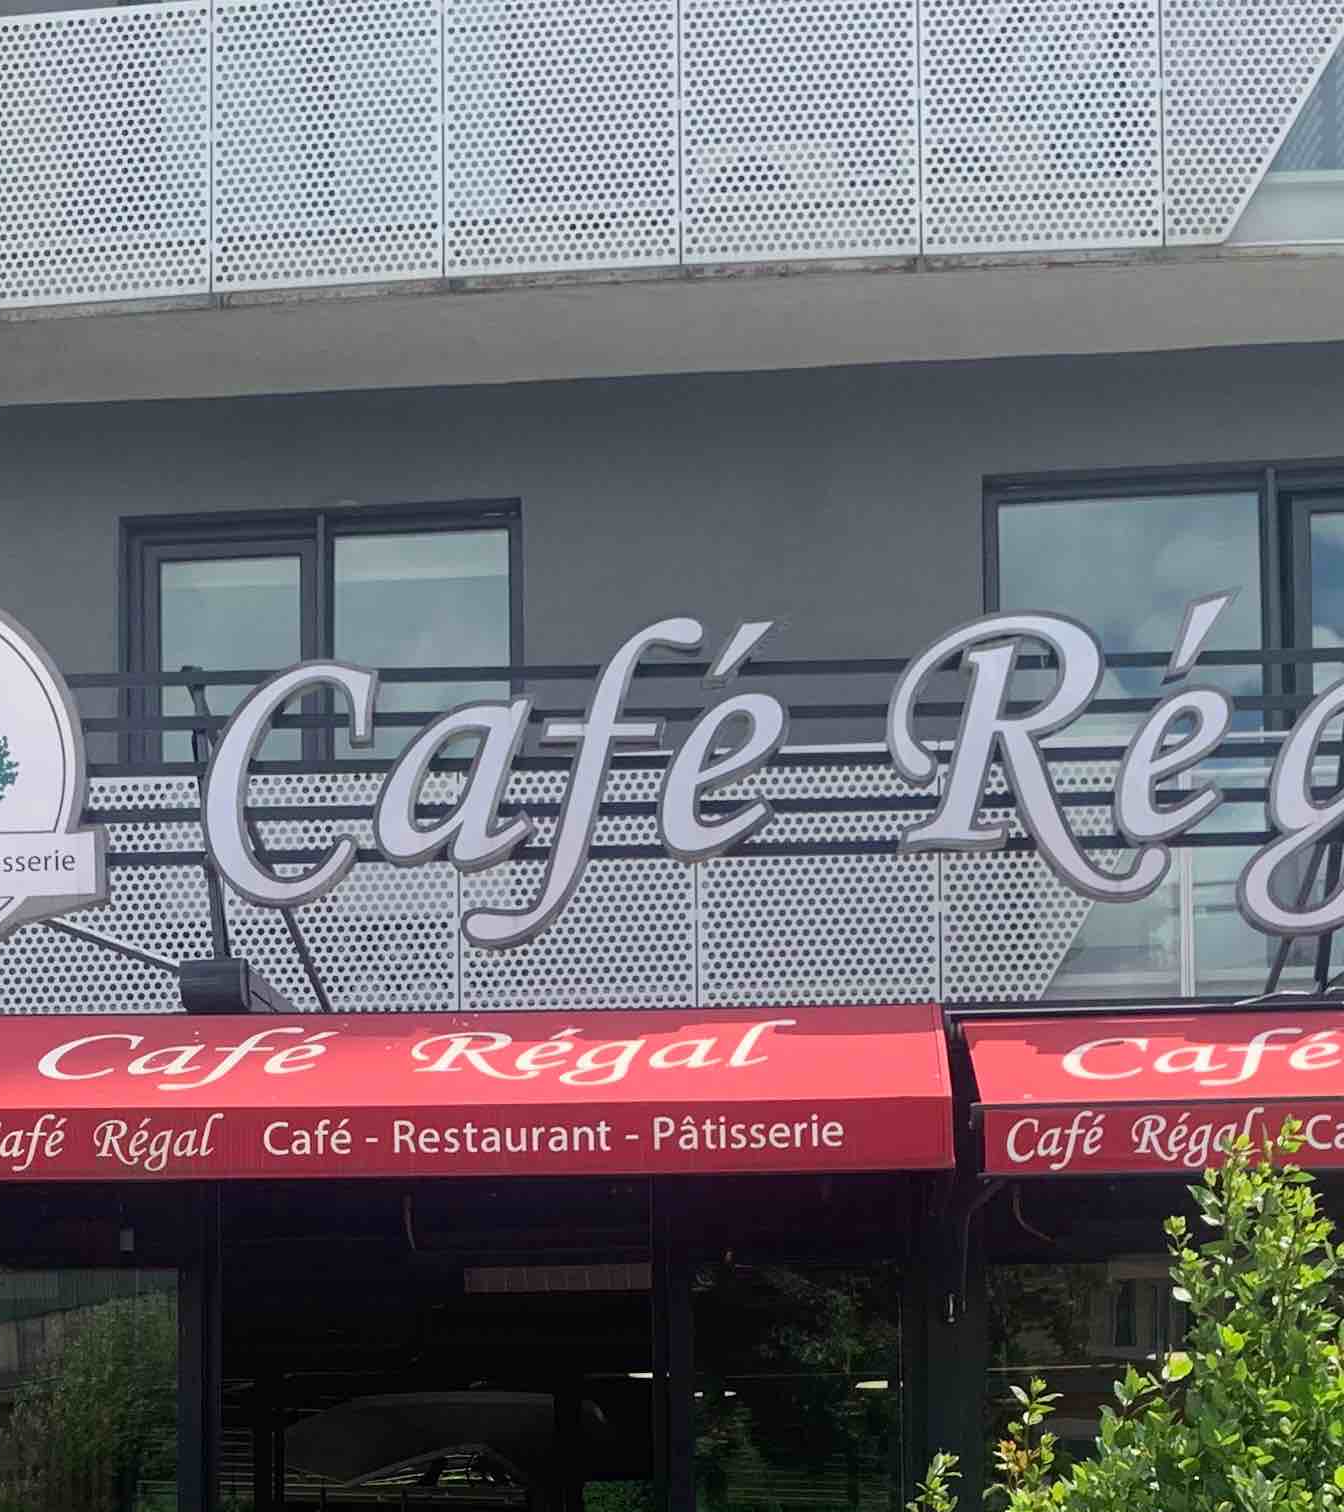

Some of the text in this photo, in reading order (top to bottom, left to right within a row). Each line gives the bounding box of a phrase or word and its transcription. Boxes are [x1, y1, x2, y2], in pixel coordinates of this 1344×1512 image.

[201, 613, 791, 950] Café
[36, 1019, 796, 1091] Café Régal
[1060, 1027, 1343, 1087] Café
[92, 1112, 225, 1172] Régal
[262, 1116, 353, 1156] Café
[393, 1119, 612, 1154] Restaurant
[653, 1114, 845, 1150] Pâtisserie
[1005, 1109, 1106, 1170] Café
